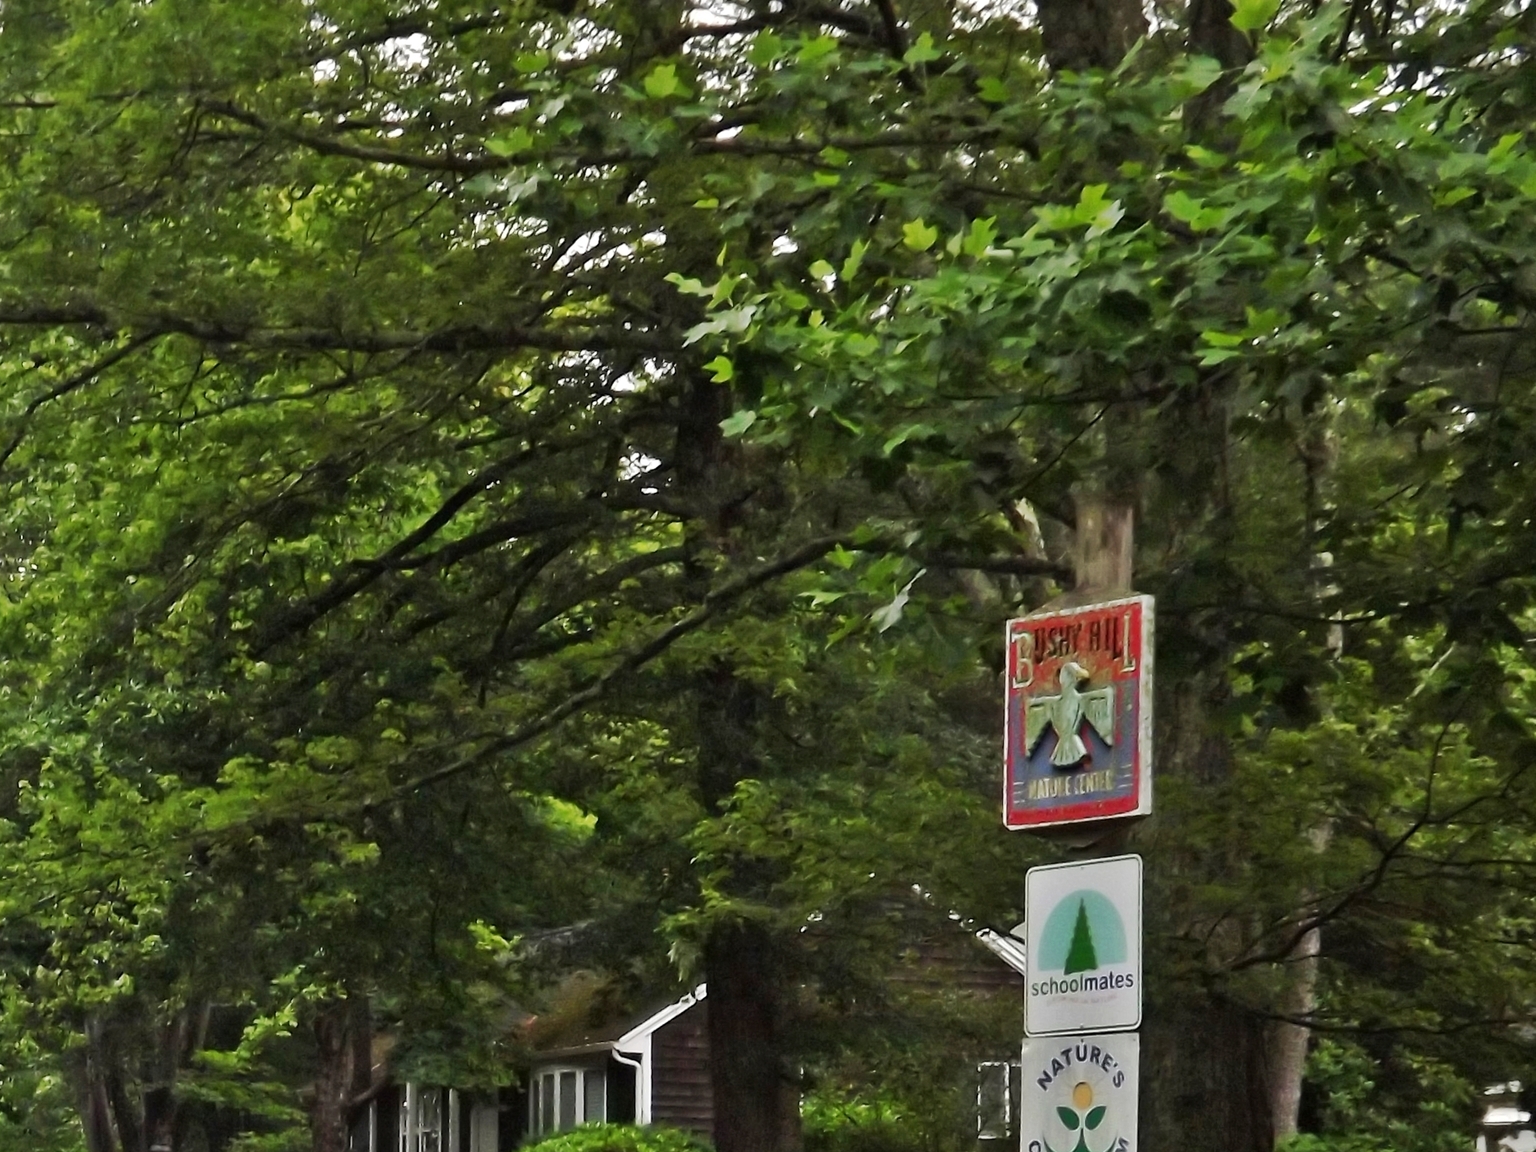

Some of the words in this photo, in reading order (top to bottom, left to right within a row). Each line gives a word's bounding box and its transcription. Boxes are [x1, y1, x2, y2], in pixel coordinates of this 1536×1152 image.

[1011, 622, 1083, 688] BUSHY
[1031, 970, 1134, 997] schoolmates
[1036, 1042, 1126, 1093] NATURE'S
